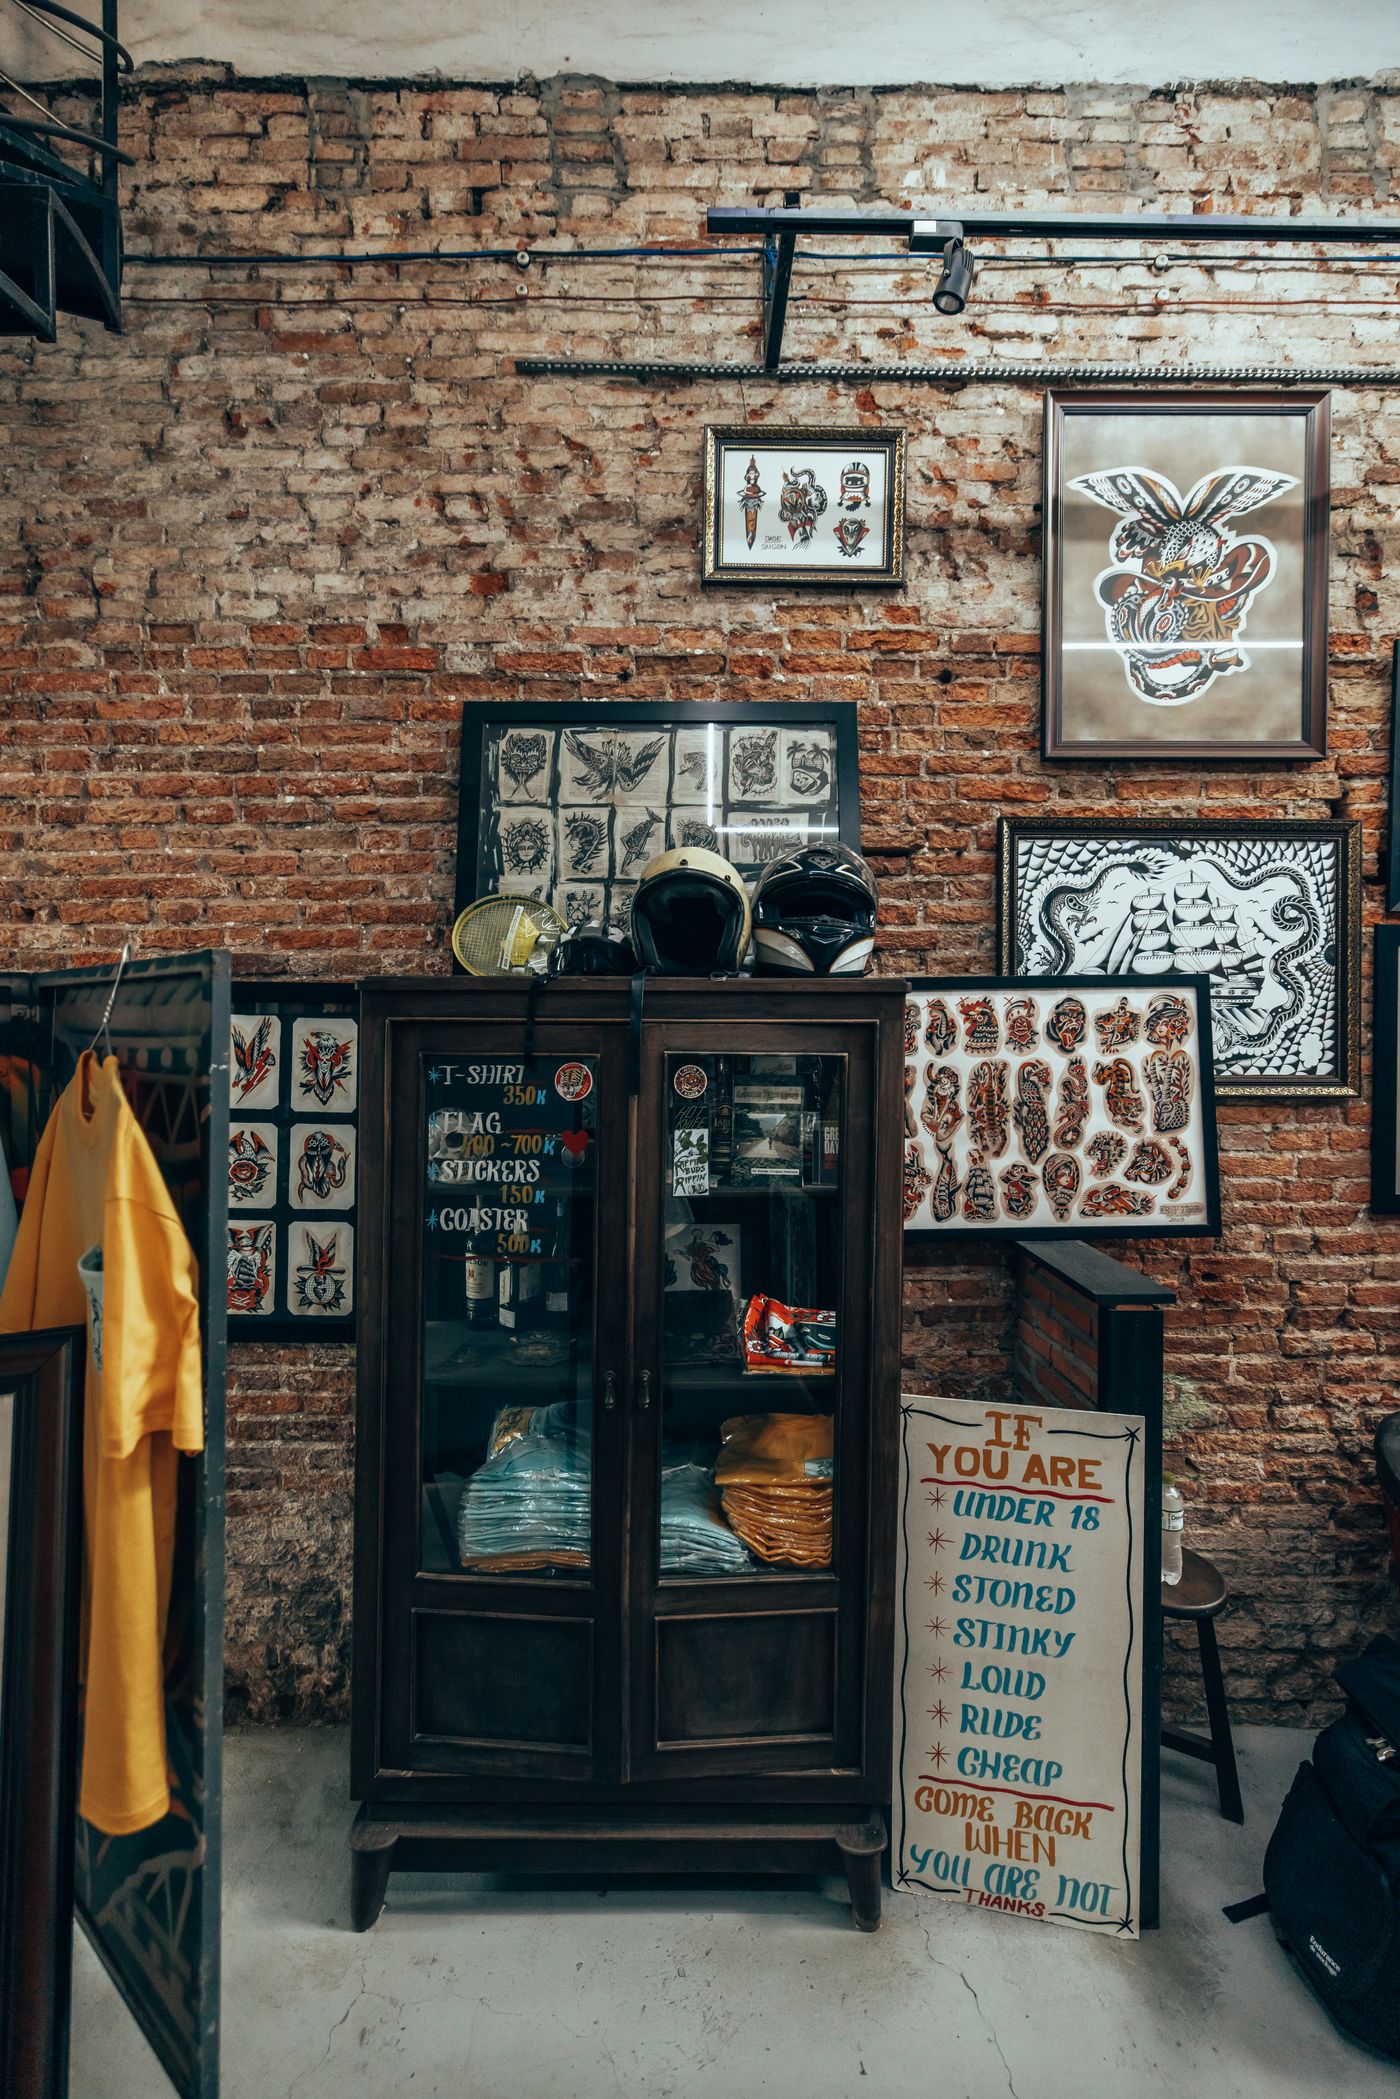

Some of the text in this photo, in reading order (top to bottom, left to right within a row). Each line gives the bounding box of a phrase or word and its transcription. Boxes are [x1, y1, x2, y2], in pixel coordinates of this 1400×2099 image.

[438, 1065, 525, 1085] T-SHIRT
[442, 1111, 504, 1134] FLAG
[441, 1160, 541, 1183] STICKERS
[439, 1207, 529, 1232] COASTER
[984, 1410, 1043, 1451] IF
[926, 1443, 1103, 1490] YOU ARE
[953, 1489, 1101, 1531] UNDER 18
[959, 1532, 1077, 1573] DRUNK
[952, 1574, 1076, 1615] STONED
[953, 1617, 1076, 1658] STINKY
[960, 1661, 1046, 1700] LOUD
[959, 1703, 1042, 1740] RUDE
[957, 1746, 1063, 1787] CHEAP
[914, 1785, 1094, 1841] COME BACK
[964, 1822, 1056, 1867] WHEN
[910, 1844, 1121, 1917] YOU ARE NOT
[963, 1887, 1046, 1917] THANKS
